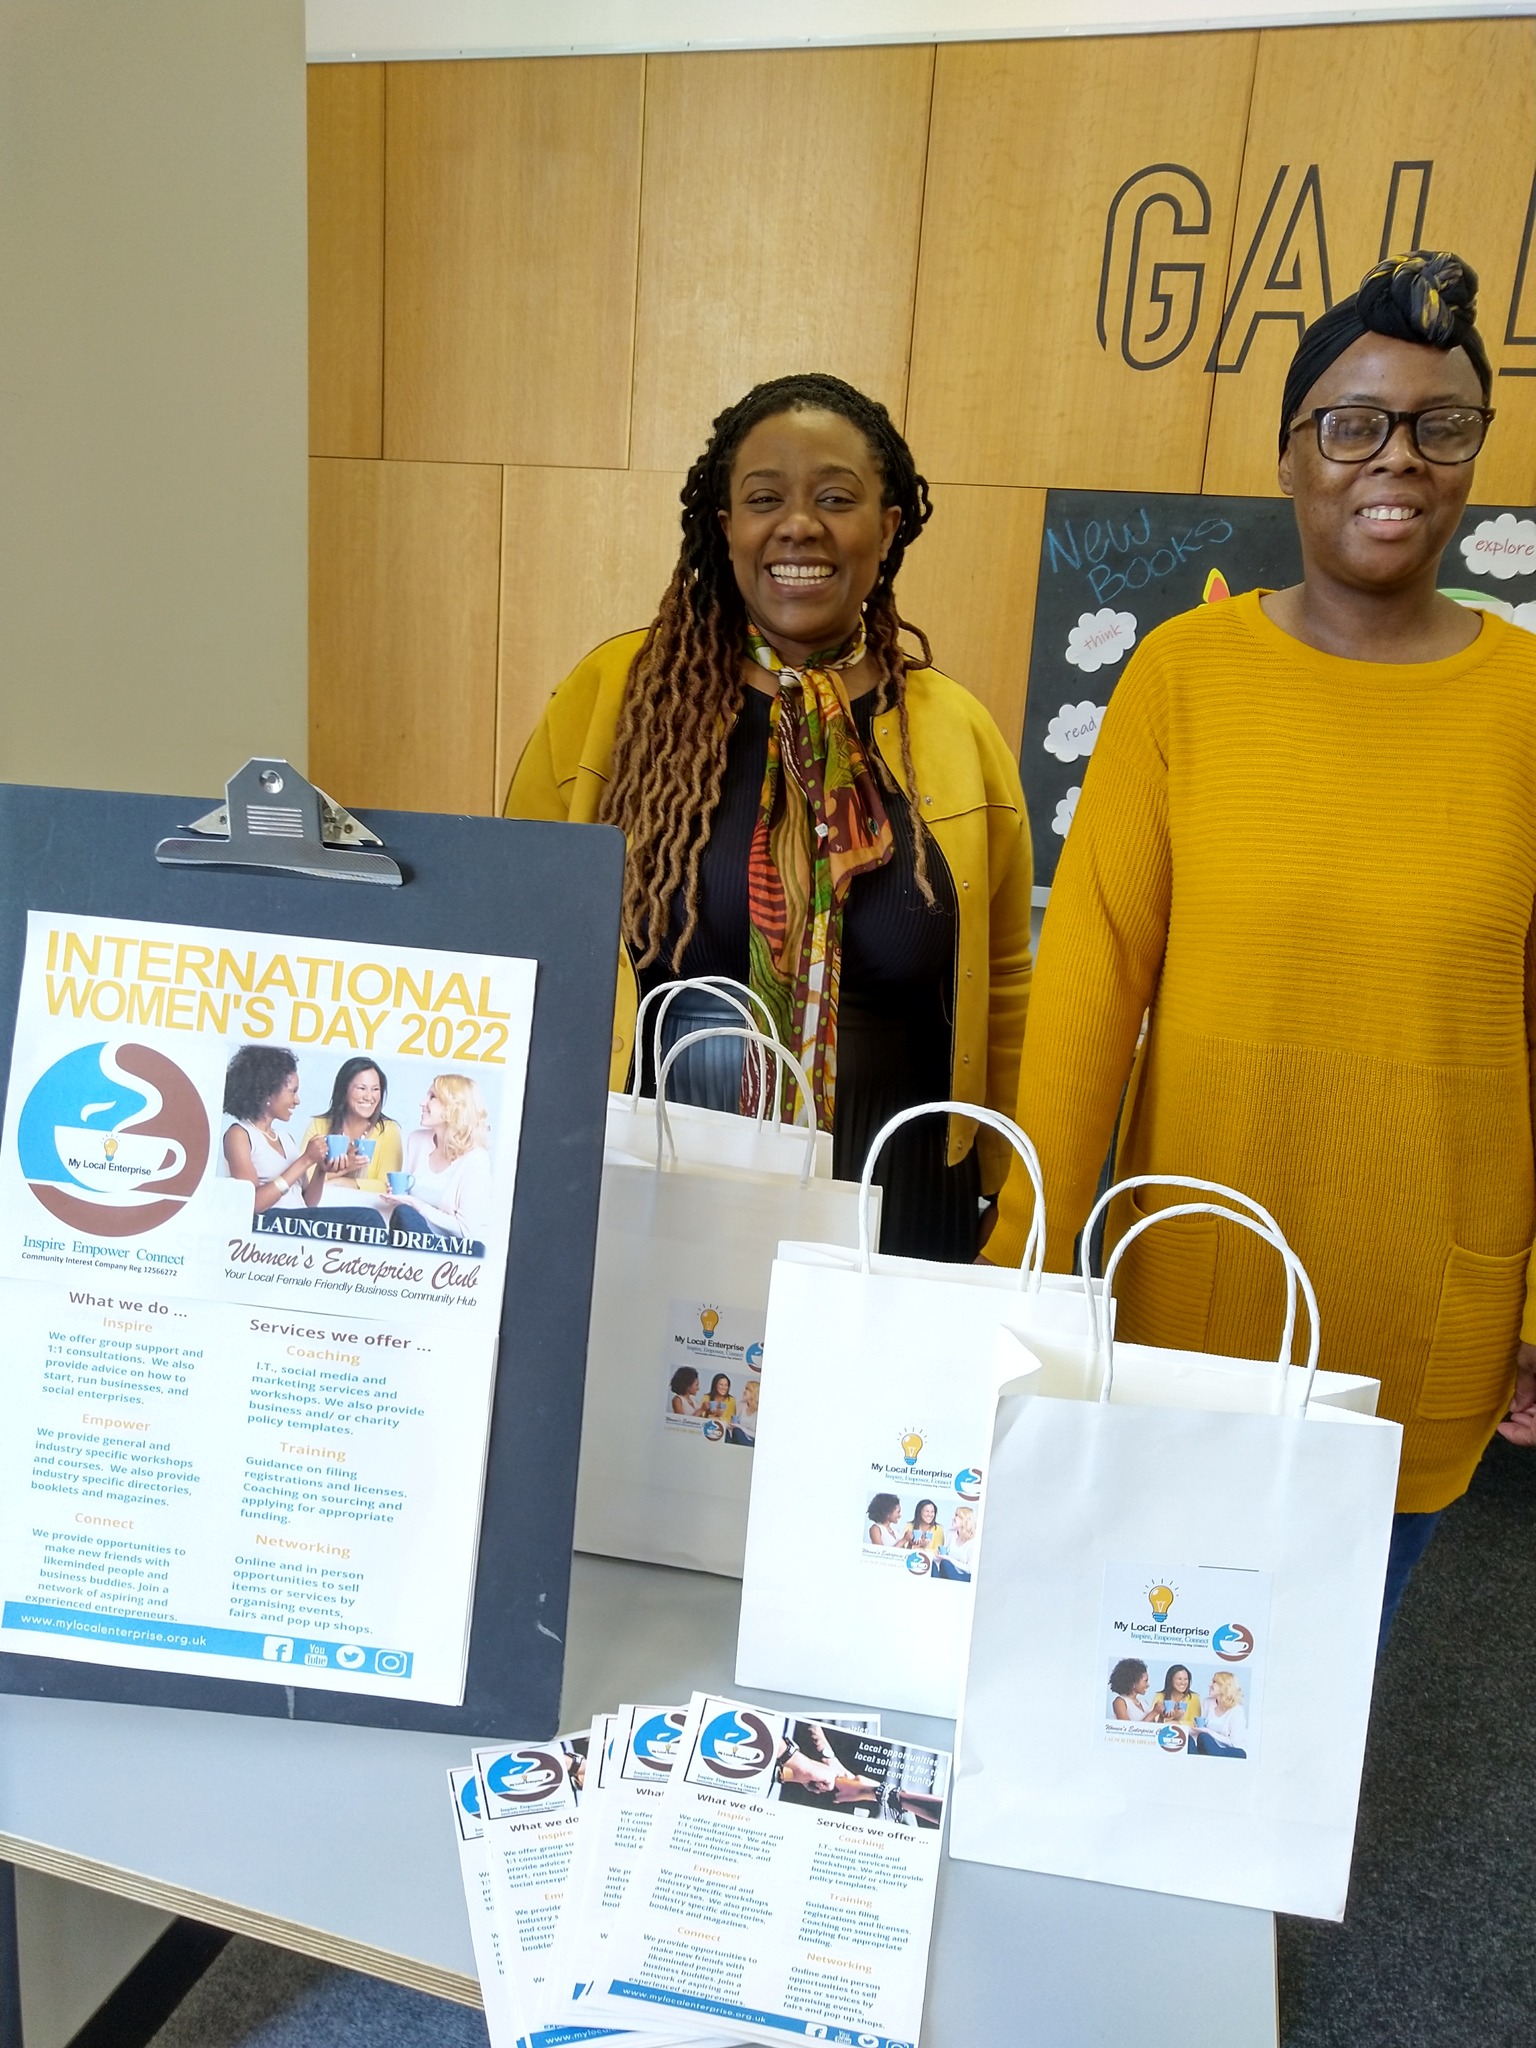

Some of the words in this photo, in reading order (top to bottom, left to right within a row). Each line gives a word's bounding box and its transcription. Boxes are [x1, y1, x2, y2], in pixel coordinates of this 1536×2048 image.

[1096, 159, 1536, 377] GA
[1475, 538, 1535, 556] explore
[1083, 623, 1123, 651] think
[1064, 716, 1097, 741] read
[46, 930, 511, 1019] INTERNATIONAL
[46, 974, 275, 1038] WOMEN'S
[289, 1000, 390, 1050] DAY
[397, 1013, 509, 1064] 2022
[68, 1157, 81, 1169] My
[83, 1159, 106, 1169] Local
[108, 1162, 151, 1175] Enterprise
[256, 1214, 342, 1241] LAUNCH
[345, 1223, 388, 1246] THE
[392, 1229, 475, 1256] DREAM!
[23, 1235, 65, 1252] Inspire
[72, 1240, 130, 1258] Empower
[136, 1248, 184, 1265] Connect
[21, 1251, 64, 1263] Community
[65, 1256, 92, 1266] Interest
[94, 1259, 127, 1271] Company
[128, 1264, 141, 1273] Reg
[144, 1266, 177, 1276] 12566272
[228, 1238, 315, 1269] Women's
[322, 1247, 423, 1284] Enterprise
[431, 1261, 481, 1289] Club
[224, 1268, 246, 1279] Your
[247, 1270, 274, 1282] Local
[275, 1273, 312, 1287] Female
[313, 1278, 353, 1293] Friendly
[354, 1283, 398, 1297] Business
[400, 1288, 455, 1305] Community
[456, 1295, 476, 1306] Hub
[69, 1291, 113, 1308] What
[118, 1300, 142, 1311] we
[147, 1301, 168, 1314] do
[103, 1316, 152, 1332] Inspire
[249, 1319, 325, 1339] Services
[331, 1331, 358, 1343] we
[364, 1333, 411, 1348] offer
[48, 1331, 66, 1340] We
[69, 1334, 96, 1344] offer
[98, 1339, 132, 1350] group
[135, 1343, 178, 1355] support
[182, 1349, 203, 1358] and
[674, 1335, 685, 1344] My
[687, 1336, 706, 1346] Local
[708, 1339, 744, 1351] Enterprise
[47, 1344, 62, 1353] 1:1
[66, 1348, 144, 1364] consultations.
[151, 1357, 168, 1366] We
[171, 1360, 194, 1369] also
[286, 1345, 360, 1366] Coaching
[45, 1359, 88, 1370] provide
[91, 1364, 127, 1375] advice
[130, 1369, 144, 1377] on
[147, 1369, 171, 1380] how
[174, 1374, 186, 1382] to
[256, 1361, 276, 1373] I.T.,
[281, 1367, 315, 1377] social
[319, 1371, 358, 1382] media
[362, 1376, 386, 1384] and
[42, 1385, 74, 1395] social
[77, 1390, 143, 1404] enterprises.
[43, 1372, 73, 1383] start,
[77, 1376, 97, 1384] run
[100, 1377, 163, 1393] businesses,
[167, 1387, 188, 1396] and
[251, 1375, 315, 1392] marketing
[319, 1384, 369, 1396] services
[373, 1390, 397, 1399] and
[250, 1388, 320, 1404] workshops.
[324, 1397, 343, 1407] We
[347, 1400, 372, 1410] also
[376, 1404, 424, 1416] provide
[82, 1413, 150, 1431] Empower
[247, 1415, 283, 1427] policy
[287, 1419, 352, 1434] templates.
[249, 1400, 301, 1415] business
[305, 1410, 334, 1419] and/
[354, 1414, 399, 1428] charity
[280, 1441, 345, 1462] Training
[871, 1463, 883, 1472] My
[886, 1464, 907, 1474] Local
[910, 1467, 953, 1479] Enterprise
[74, 1512, 134, 1529] Connect
[255, 1534, 350, 1558] Networking
[234, 1555, 275, 1568] Online
[279, 1563, 302, 1571] and
[306, 1565, 317, 1574] in
[320, 1568, 363, 1579] person
[233, 1570, 317, 1587] opportunities
[321, 1581, 334, 1589] to
[338, 1583, 359, 1592] sell
[231, 1581, 266, 1593] items
[287, 1590, 336, 1602] services
[340, 1595, 355, 1607] by
[230, 1596, 295, 1613] organising
[298, 1605, 342, 1618] events,
[20, 1615, 206, 1645] www.mylocalenterprise.org.uk
[229, 1607, 256, 1618] fairs
[260, 1613, 283, 1622] and
[287, 1617, 310, 1627] pop
[314, 1620, 329, 1630] up
[333, 1621, 372, 1634] shops.
[1114, 1621, 1128, 1632] My
[1131, 1622, 1157, 1632] Local
[1160, 1624, 1210, 1637] Enterprise
[309, 1643, 326, 1655] You
[859, 1741, 882, 1754] Local
[854, 1751, 876, 1763] local
[876, 1757, 916, 1772] solutions
[916, 1765, 929, 1776] for
[864, 1764, 886, 1776] local
[886, 1770, 935, 1787] community
[697, 1793, 726, 1805] What
[749, 1804, 763, 1812] do
[510, 1818, 542, 1832] What
[545, 1820, 562, 1828] we
[565, 1815, 580, 1825] do
[716, 1809, 750, 1821] Inspire
[537, 1830, 574, 1840] Inspire
[816, 1817, 863, 1832] Services
[867, 1828, 883, 1836] we
[887, 1831, 915, 1841] offer
[838, 1834, 884, 1849] Coaching
[693, 1864, 739, 1880] Empower
[830, 1893, 872, 1908] Training
[677, 1927, 720, 1942] Connect
[806, 1952, 871, 1974] Networking
[622, 1988, 765, 2022] www.mylocalenterprise.org.uk
